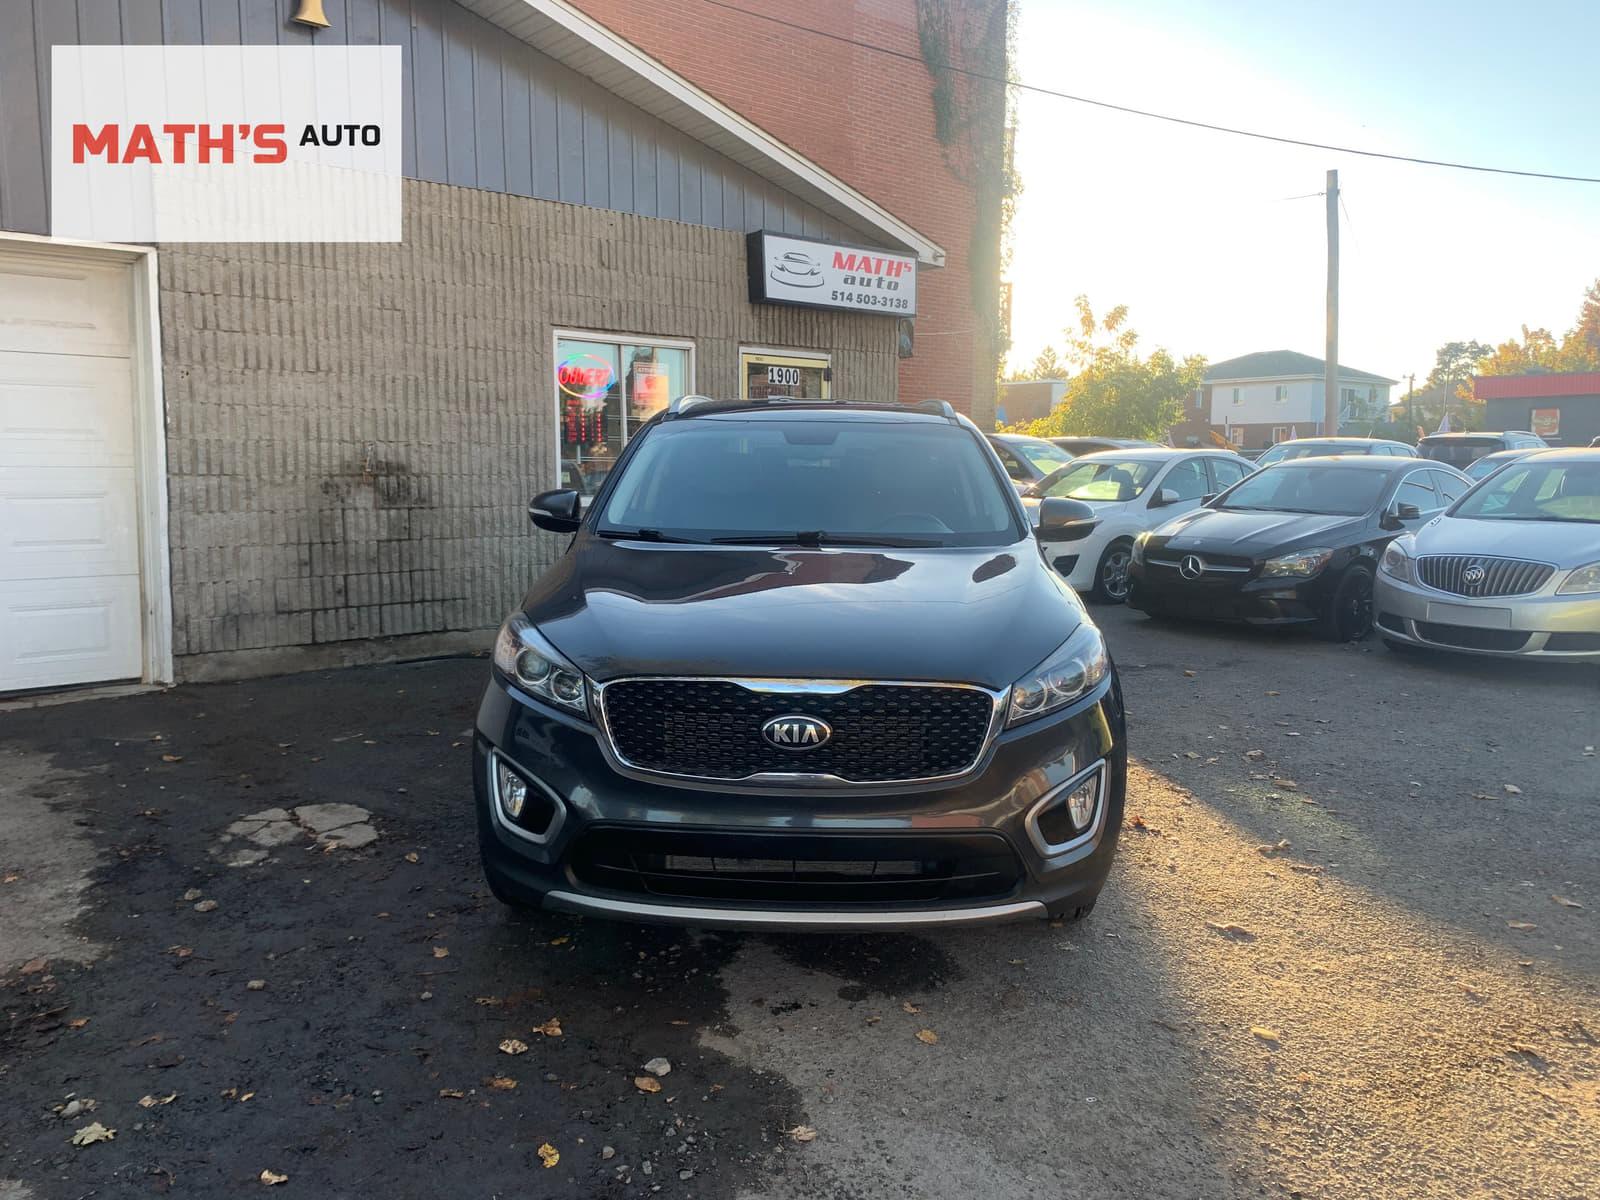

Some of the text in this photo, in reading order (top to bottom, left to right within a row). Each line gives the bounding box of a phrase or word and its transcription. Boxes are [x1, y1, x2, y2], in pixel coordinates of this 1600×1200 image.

[843, 274, 899, 291] auto
[831, 290, 909, 309] 514 503-3138
[769, 367, 799, 385] 1900
[773, 723, 820, 743] KIA
